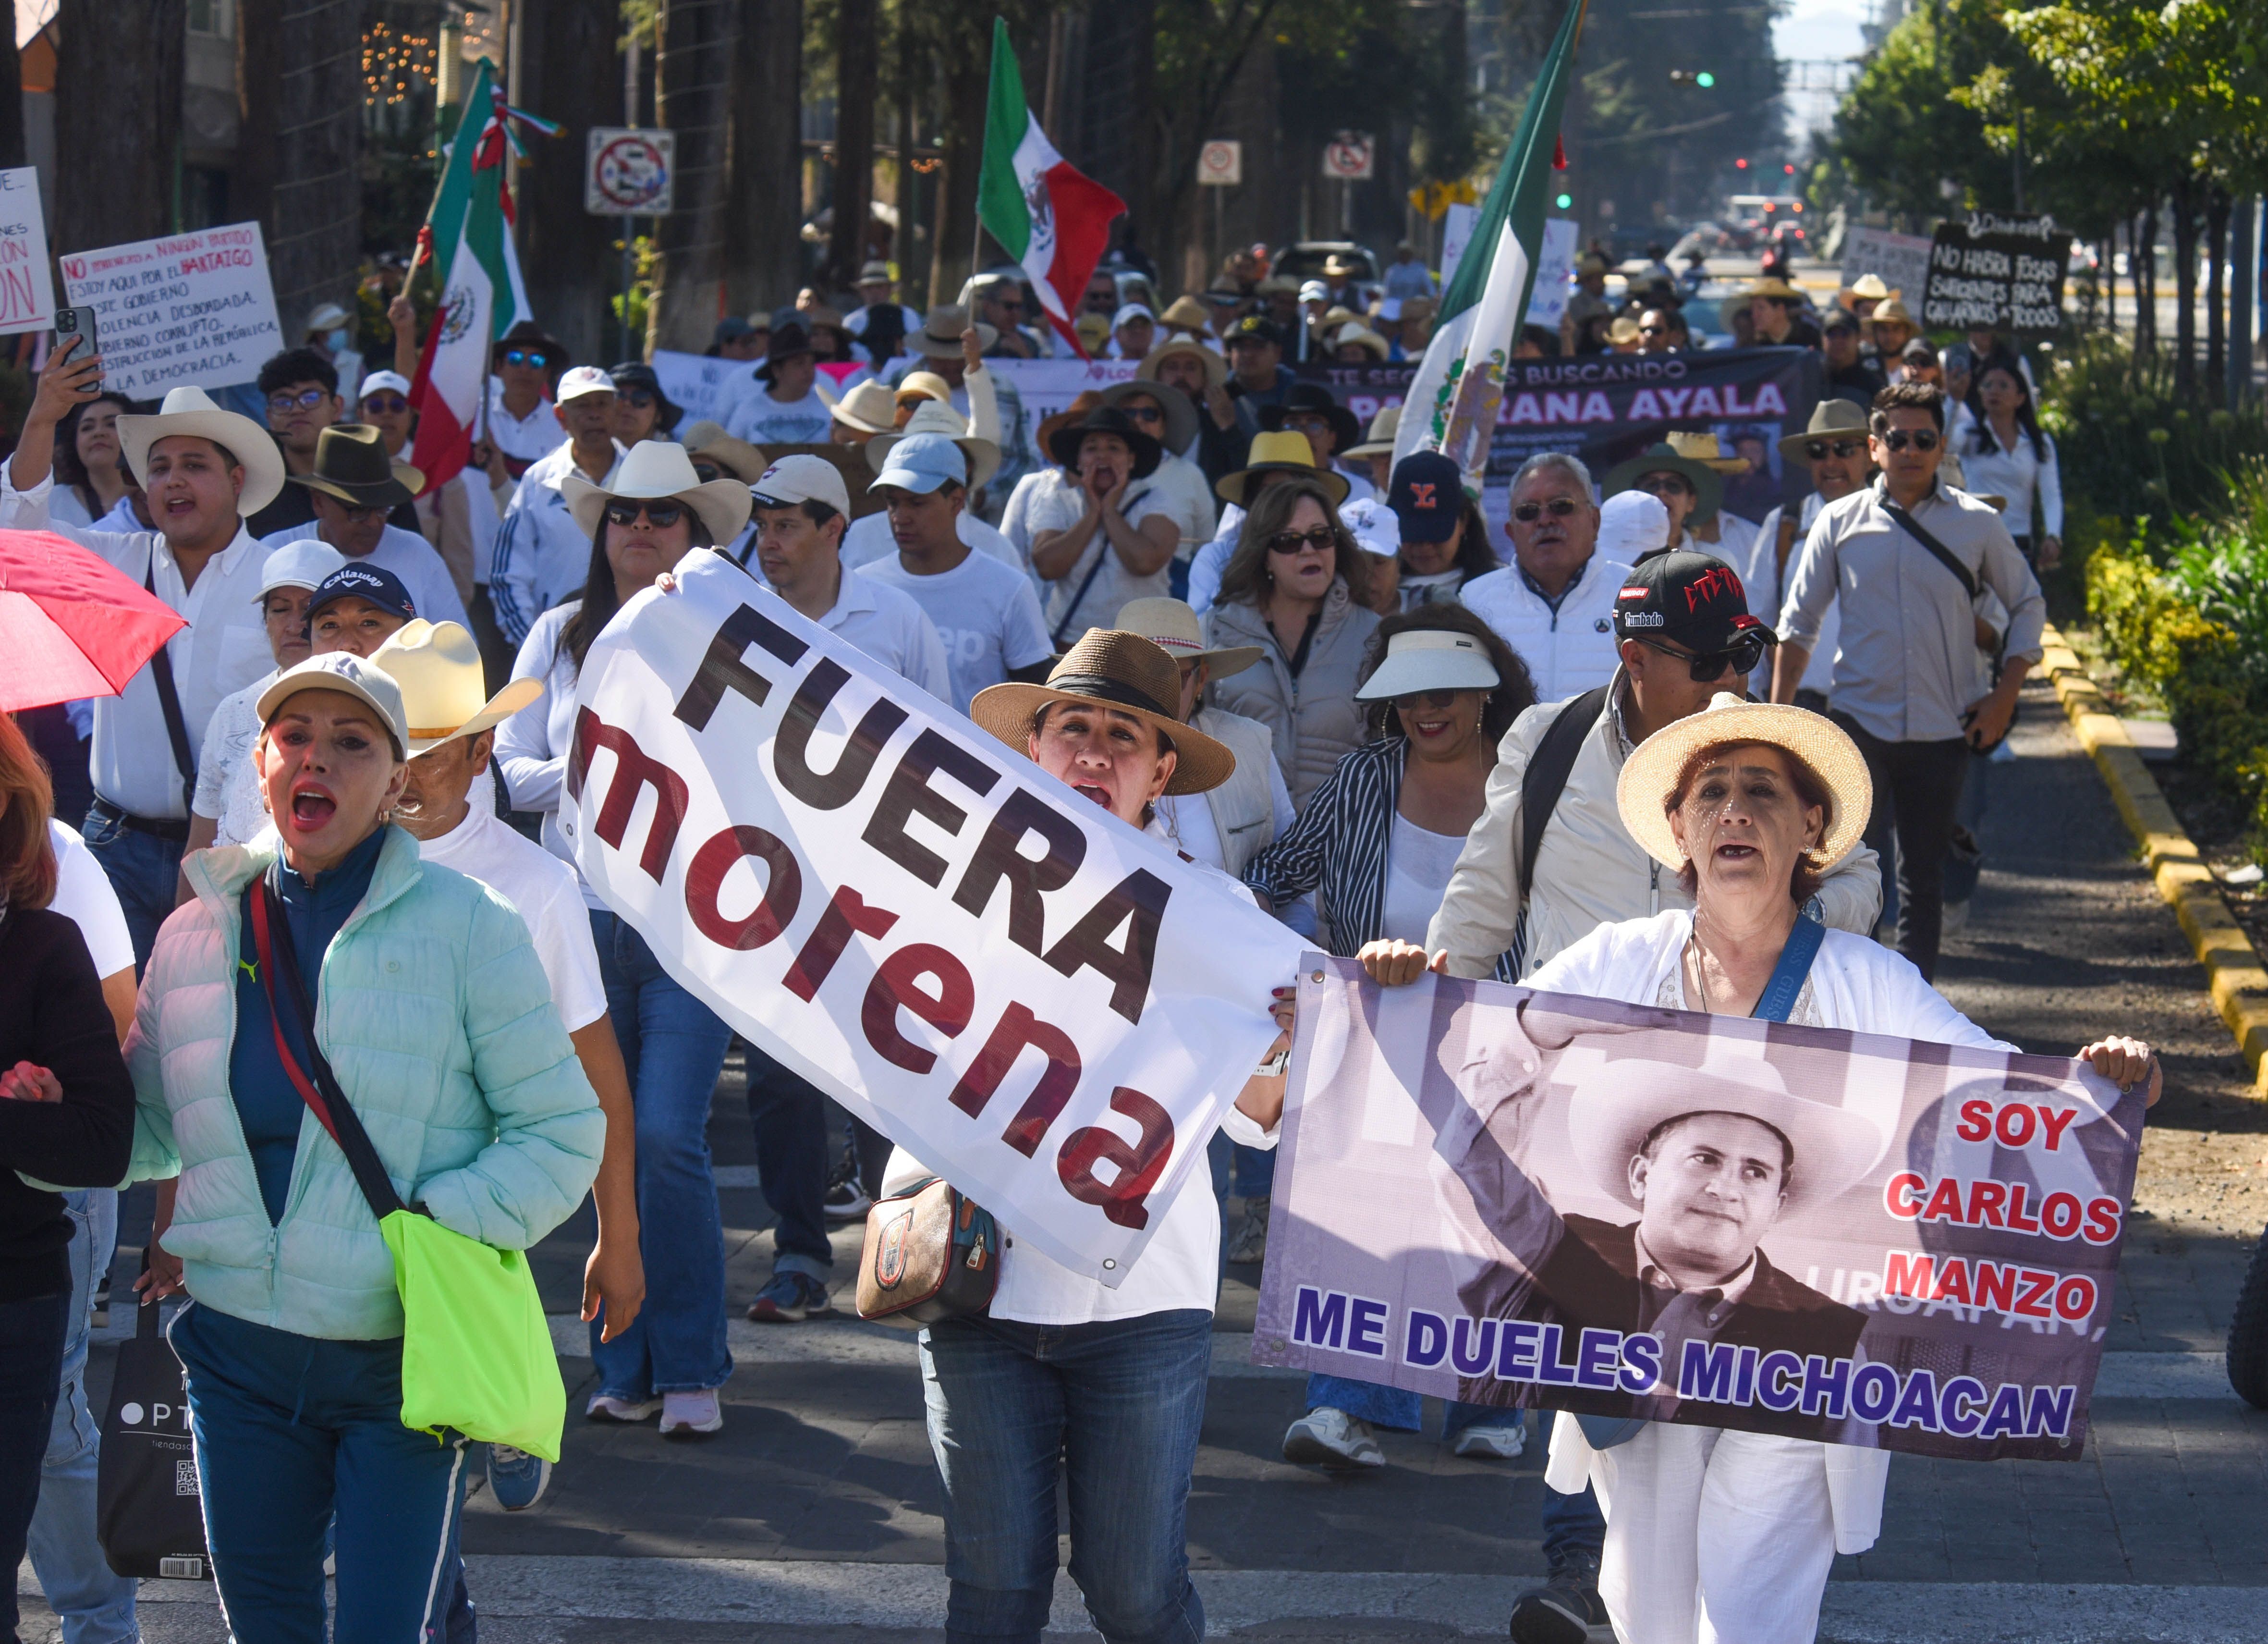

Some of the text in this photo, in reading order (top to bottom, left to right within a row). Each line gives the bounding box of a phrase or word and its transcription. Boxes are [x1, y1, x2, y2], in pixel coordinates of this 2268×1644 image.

[64, 258, 87, 281] NO
[207, 230, 253, 248] PARTIDO
[1933, 244, 1961, 270] NO
[141, 269, 164, 285] POR
[167, 266, 183, 279] EL
[90, 282, 189, 314] STE GOBIERNO
[97, 309, 161, 336] IOLENCIA
[2009, 304, 2060, 331] TODOS
[98, 333, 150, 355] OBIERNO
[176, 341, 190, 354] DE
[194, 336, 210, 350] LA
[116, 374, 136, 390] LA
[1327, 369, 1360, 384] TE
[1526, 360, 1688, 385] BUSCANDO
[1627, 382, 1788, 421] AYALA
[324, 570, 383, 589] Callaway
[672, 602, 1173, 1027] FUERA
[567, 704, 1175, 1231] morena
[1764, 975, 1794, 1020] GUES
[1956, 1099, 2078, 1152] SOY
[1885, 1171, 2122, 1244] CARLOS
[1882, 1251, 2097, 1321] MANZO
[1292, 1286, 2076, 1439] ME DUELES MICHOACAN
